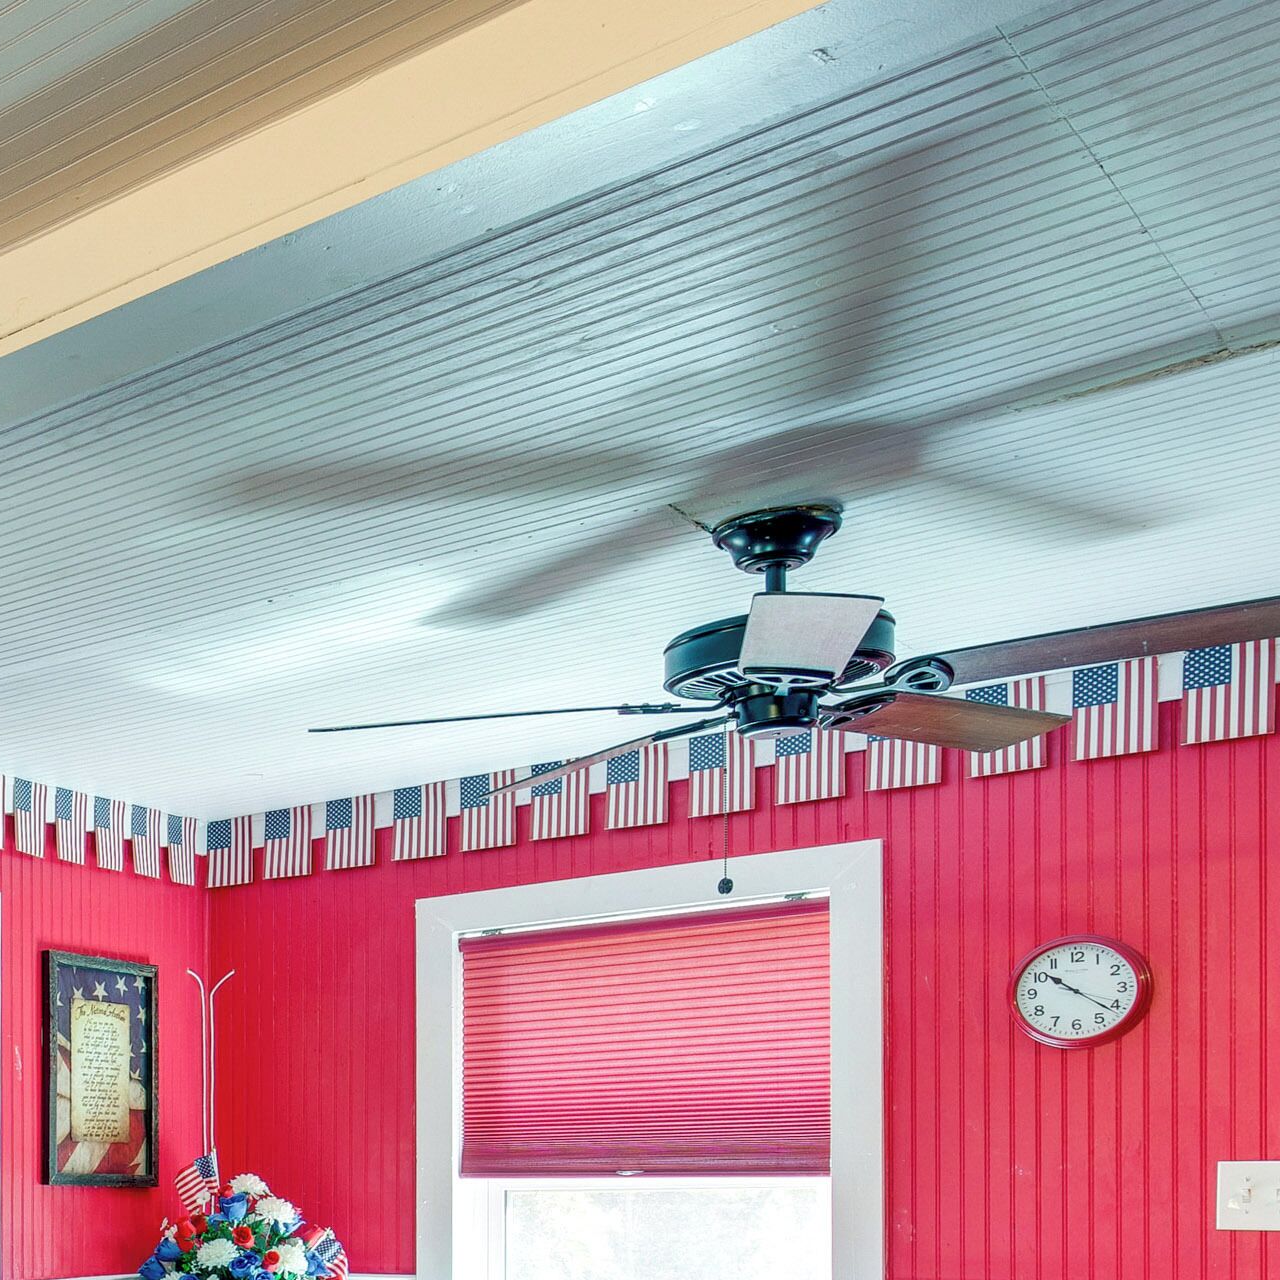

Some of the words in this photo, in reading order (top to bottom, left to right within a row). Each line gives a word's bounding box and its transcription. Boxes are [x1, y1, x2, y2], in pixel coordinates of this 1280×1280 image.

[1071, 951, 1085, 963] 12
[1096, 954, 1100, 965] 1
[1050, 958, 1057, 969] 11
[1110, 964, 1120, 976] 2
[1034, 971, 1048, 983] 10
[1117, 982, 1127, 993] 3
[1027, 988, 1037, 999] 9
[1110, 999, 1121, 1010] 4
[1034, 1005, 1044, 1016] 8
[1050, 1016, 1060, 1027] 7
[1094, 1012, 1105, 1024] 5
[1072, 1019, 1082, 1030] 6
